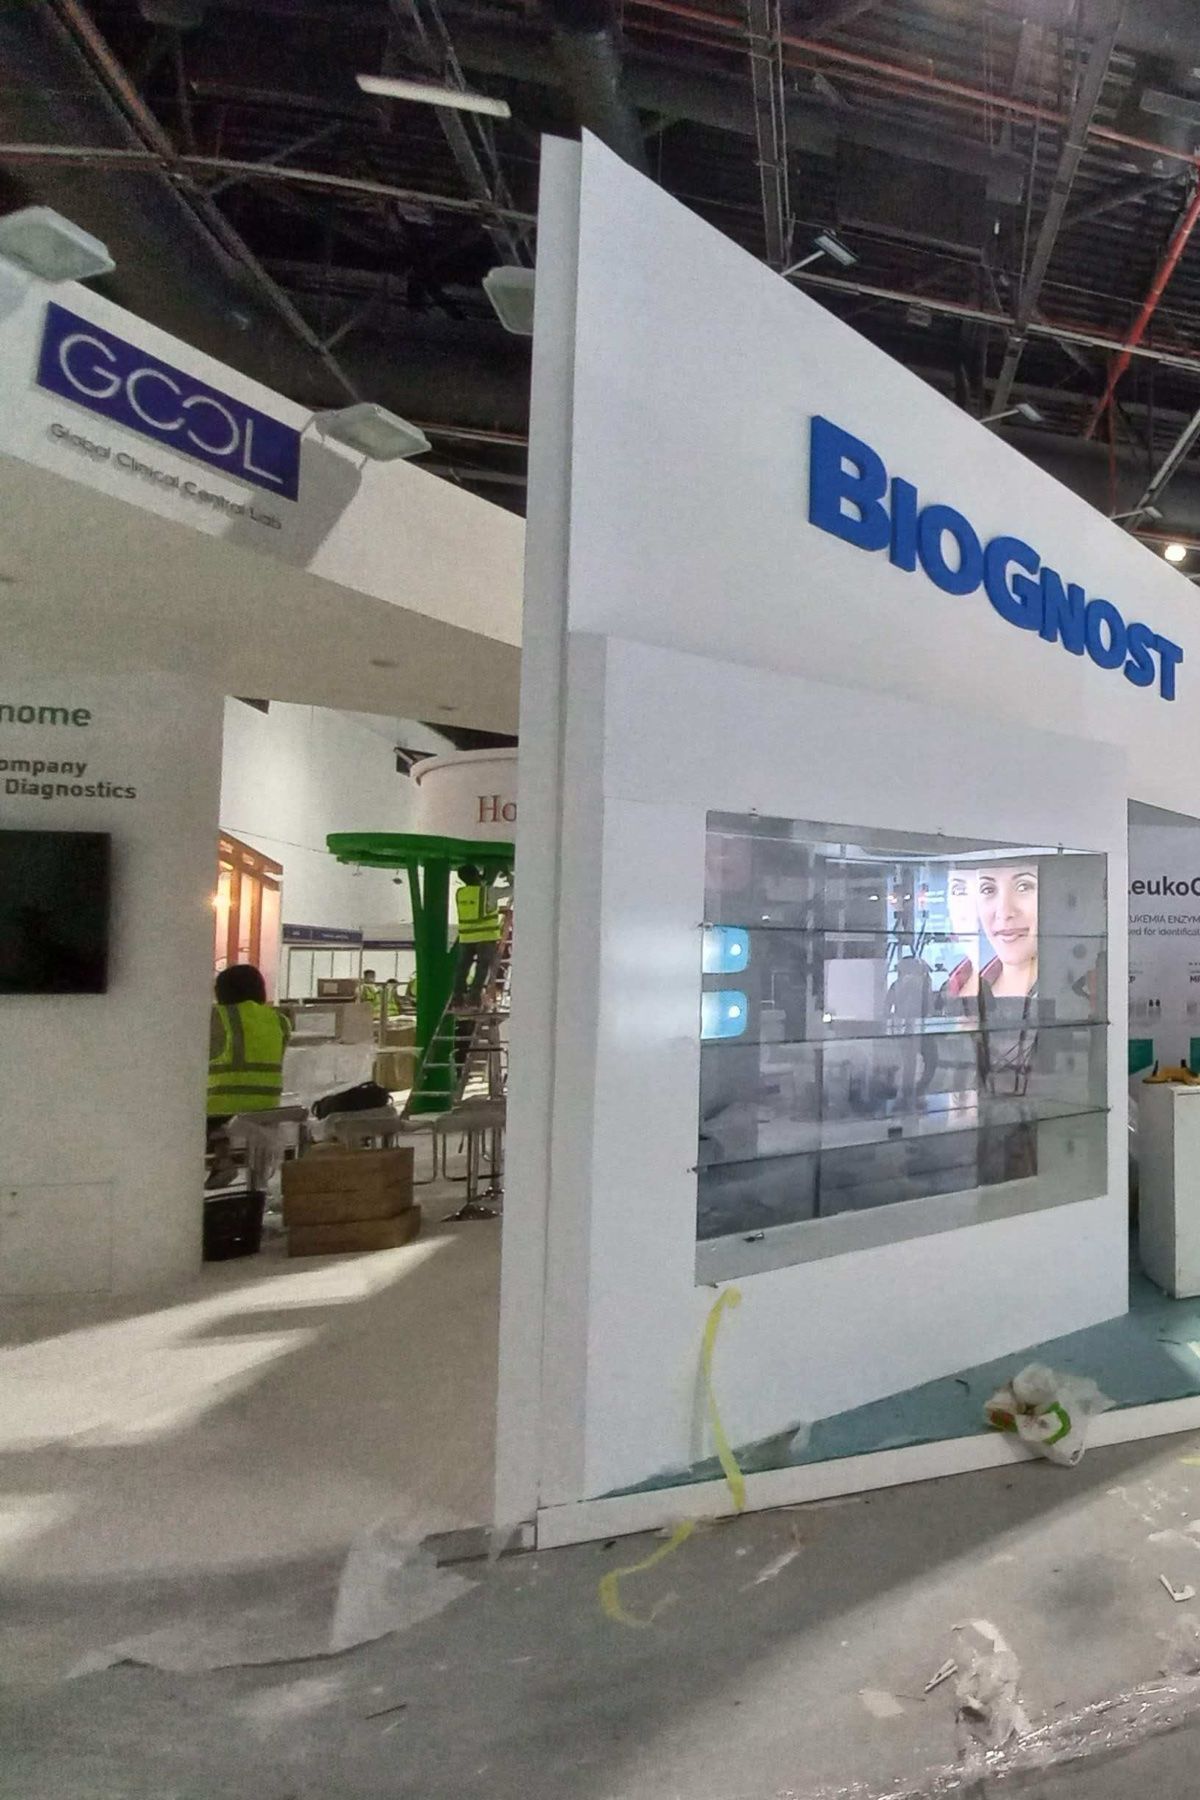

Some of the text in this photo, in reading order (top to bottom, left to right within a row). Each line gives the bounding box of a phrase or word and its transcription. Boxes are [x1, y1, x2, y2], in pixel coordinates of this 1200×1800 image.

[50, 423, 111, 459] Global
[117, 452, 180, 488] Clinical
[250, 507, 282, 530] Lab
[5, 778, 137, 800] Diagnostics
[477, 795, 517, 823] Ho
[1129, 914, 1166, 924] UKEMIA
[1144, 927, 1156, 936] for
